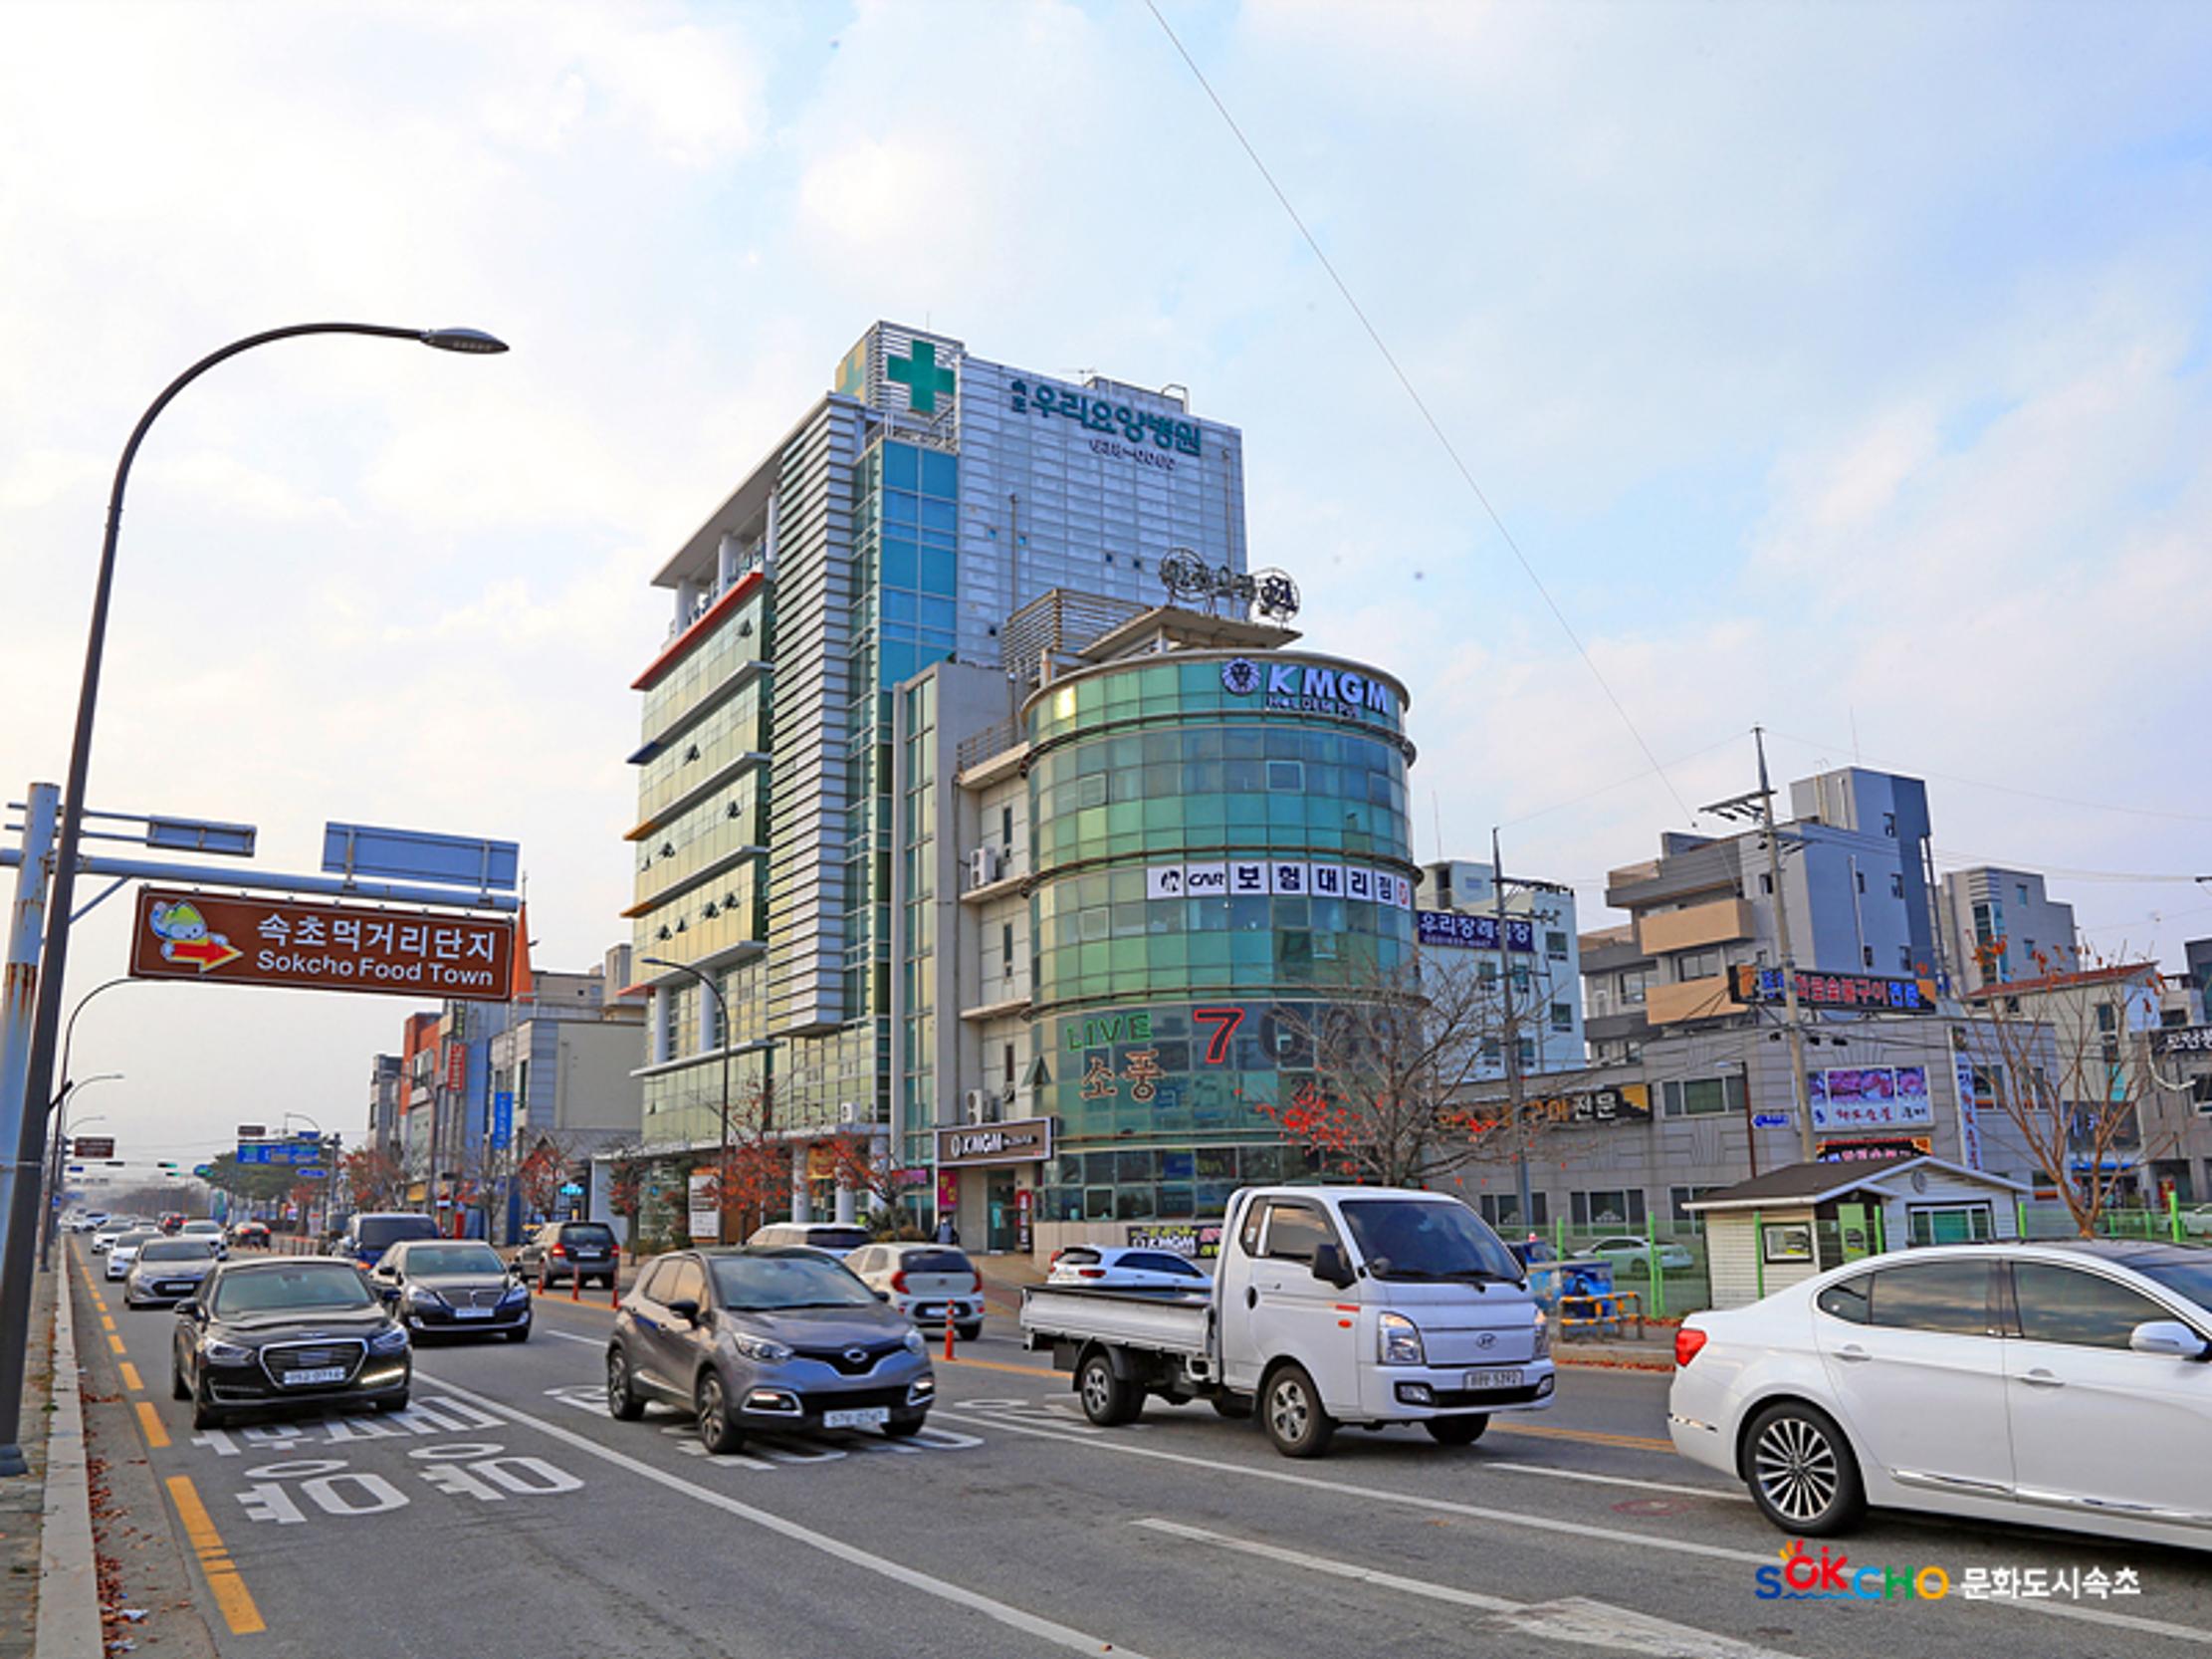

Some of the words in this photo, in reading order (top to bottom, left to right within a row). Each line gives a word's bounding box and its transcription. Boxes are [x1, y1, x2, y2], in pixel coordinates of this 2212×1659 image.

[1030, 384, 1201, 457] 우리요양병원
[1269, 664, 1389, 714] KMGM
[1238, 865, 1392, 900] 보험대리점
[256, 913, 495, 963] 속초먹거리단지
[257, 949, 353, 976] Sokcho
[359, 958, 421, 982] Food
[429, 963, 493, 986] Town
[1067, 1014, 1151, 1052] LIVE
[1080, 1049, 1166, 1103] 소풍
